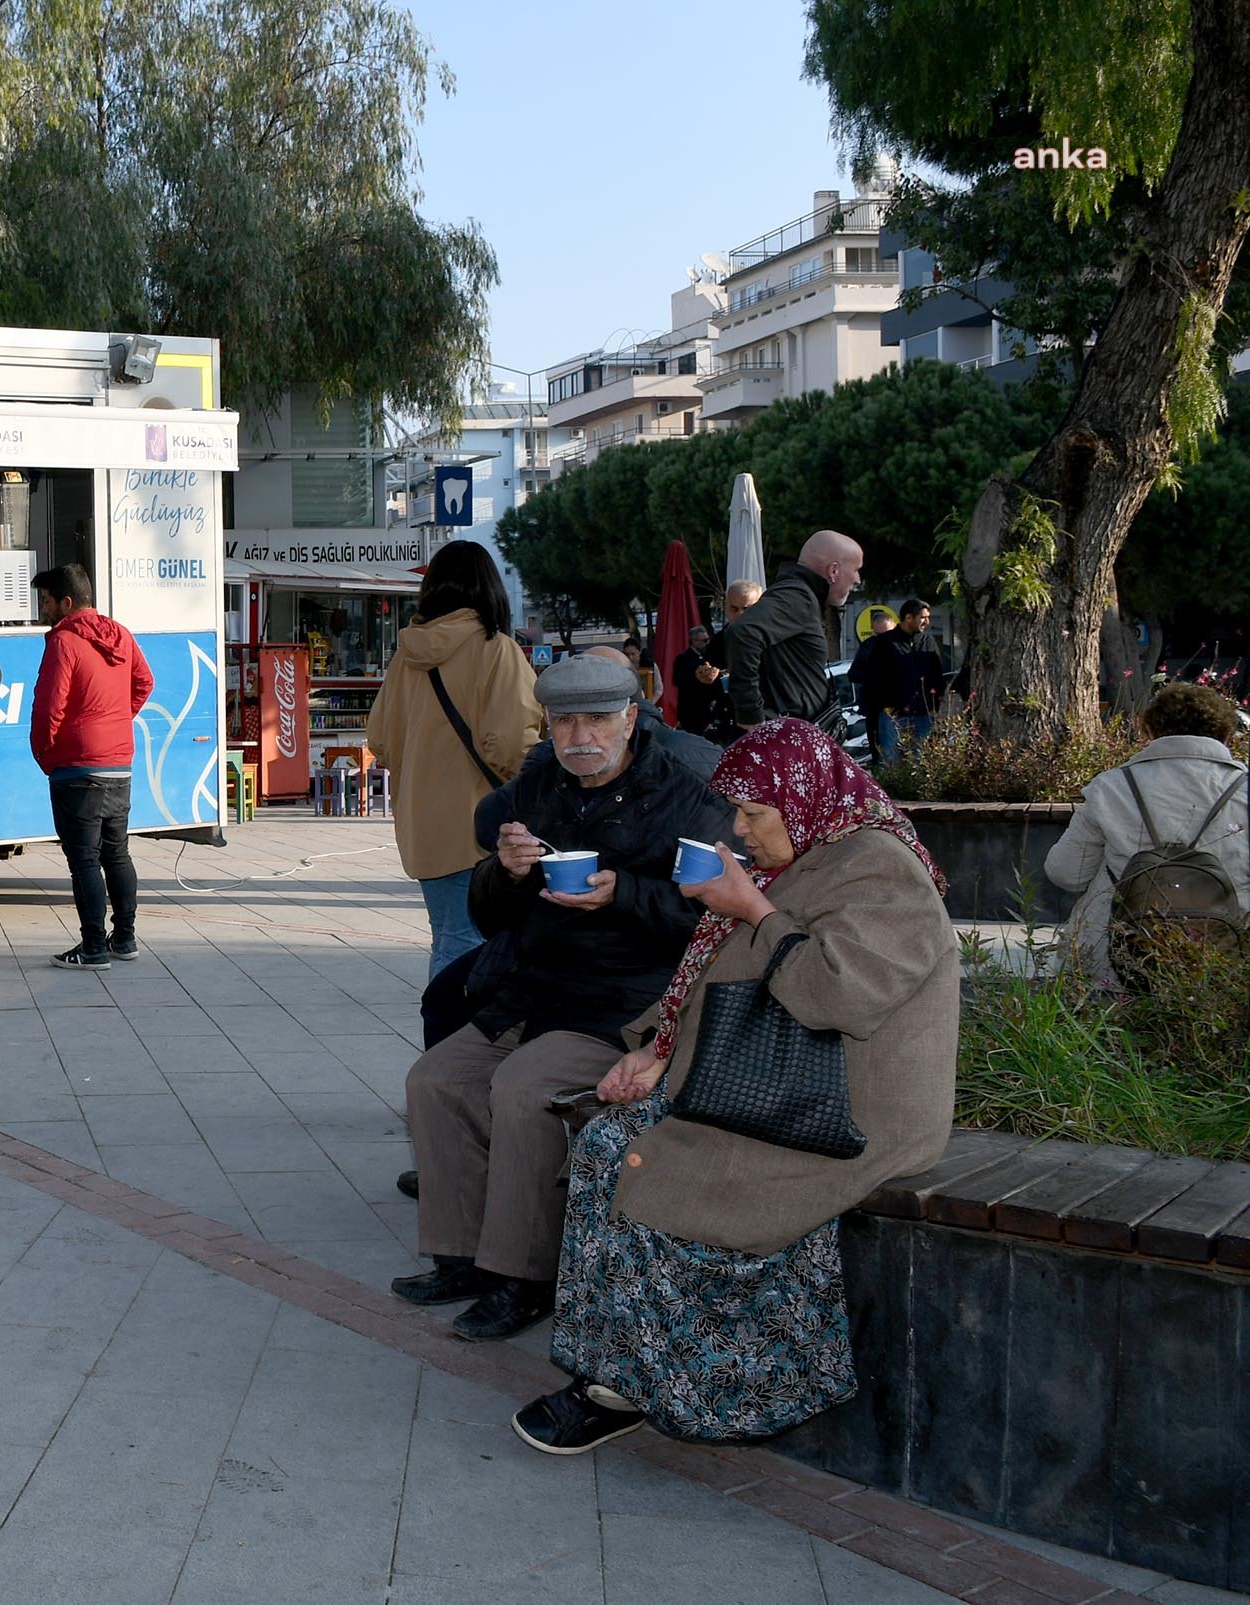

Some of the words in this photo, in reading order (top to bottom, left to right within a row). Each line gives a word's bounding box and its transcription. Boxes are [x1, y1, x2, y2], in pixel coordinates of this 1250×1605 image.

[312, 542, 355, 563] SAĞLIĞI
[359, 541, 421, 562] POLİKLİNİĞİ
[158, 558, 207, 579] GÜNEL
